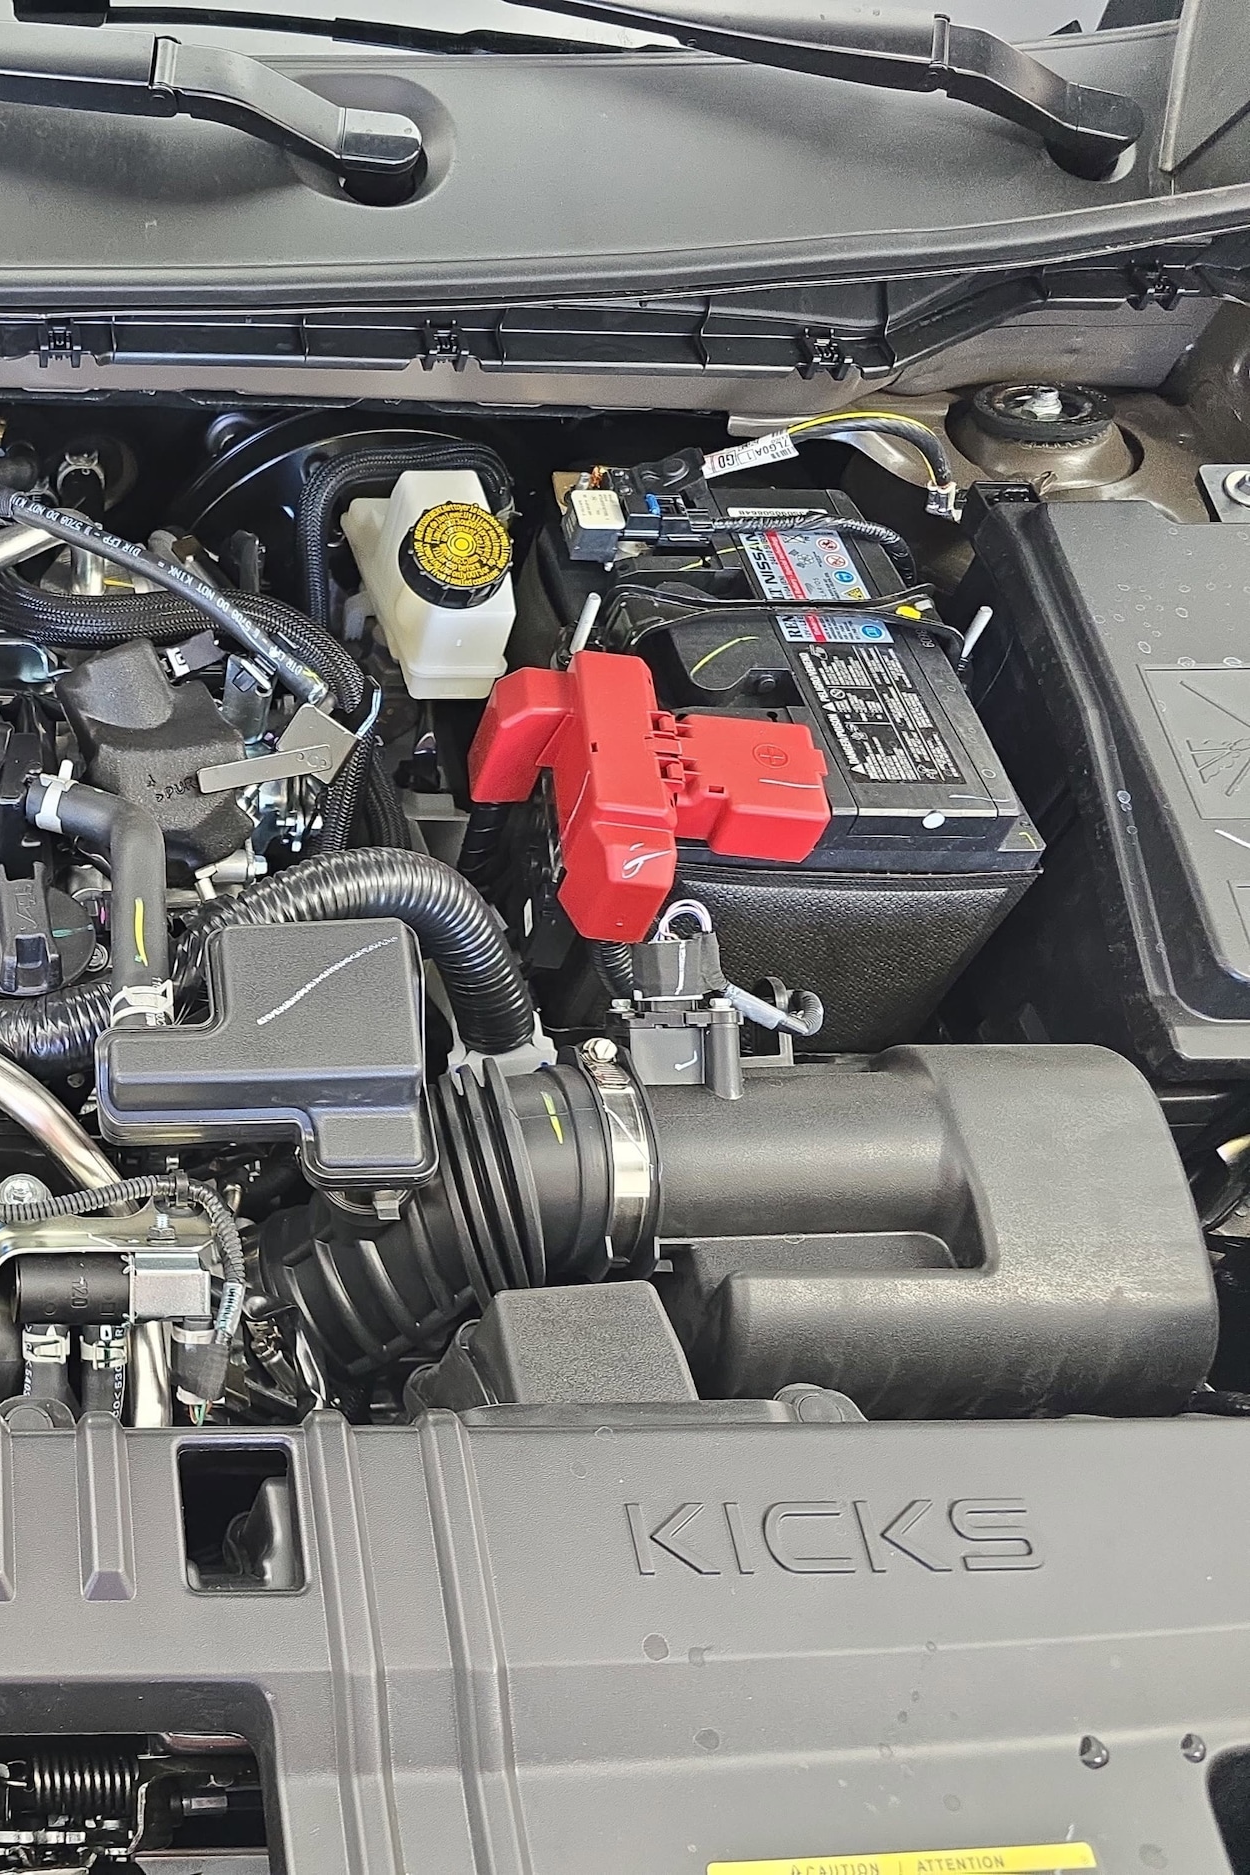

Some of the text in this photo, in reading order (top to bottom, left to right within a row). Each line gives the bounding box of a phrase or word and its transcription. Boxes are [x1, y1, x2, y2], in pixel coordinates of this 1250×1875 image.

[28, 502, 46, 515] NOT
[46, 510, 59, 521] DO
[745, 533, 779, 585] NISSAN
[168, 565, 194, 585] KINK
[196, 584, 215, 600] NOT
[217, 597, 230, 612] DO
[768, 588, 803, 638] RENLT
[623, 1498, 1044, 1577] KICKS
[917, 1855, 1004, 1872] ATTENTION
